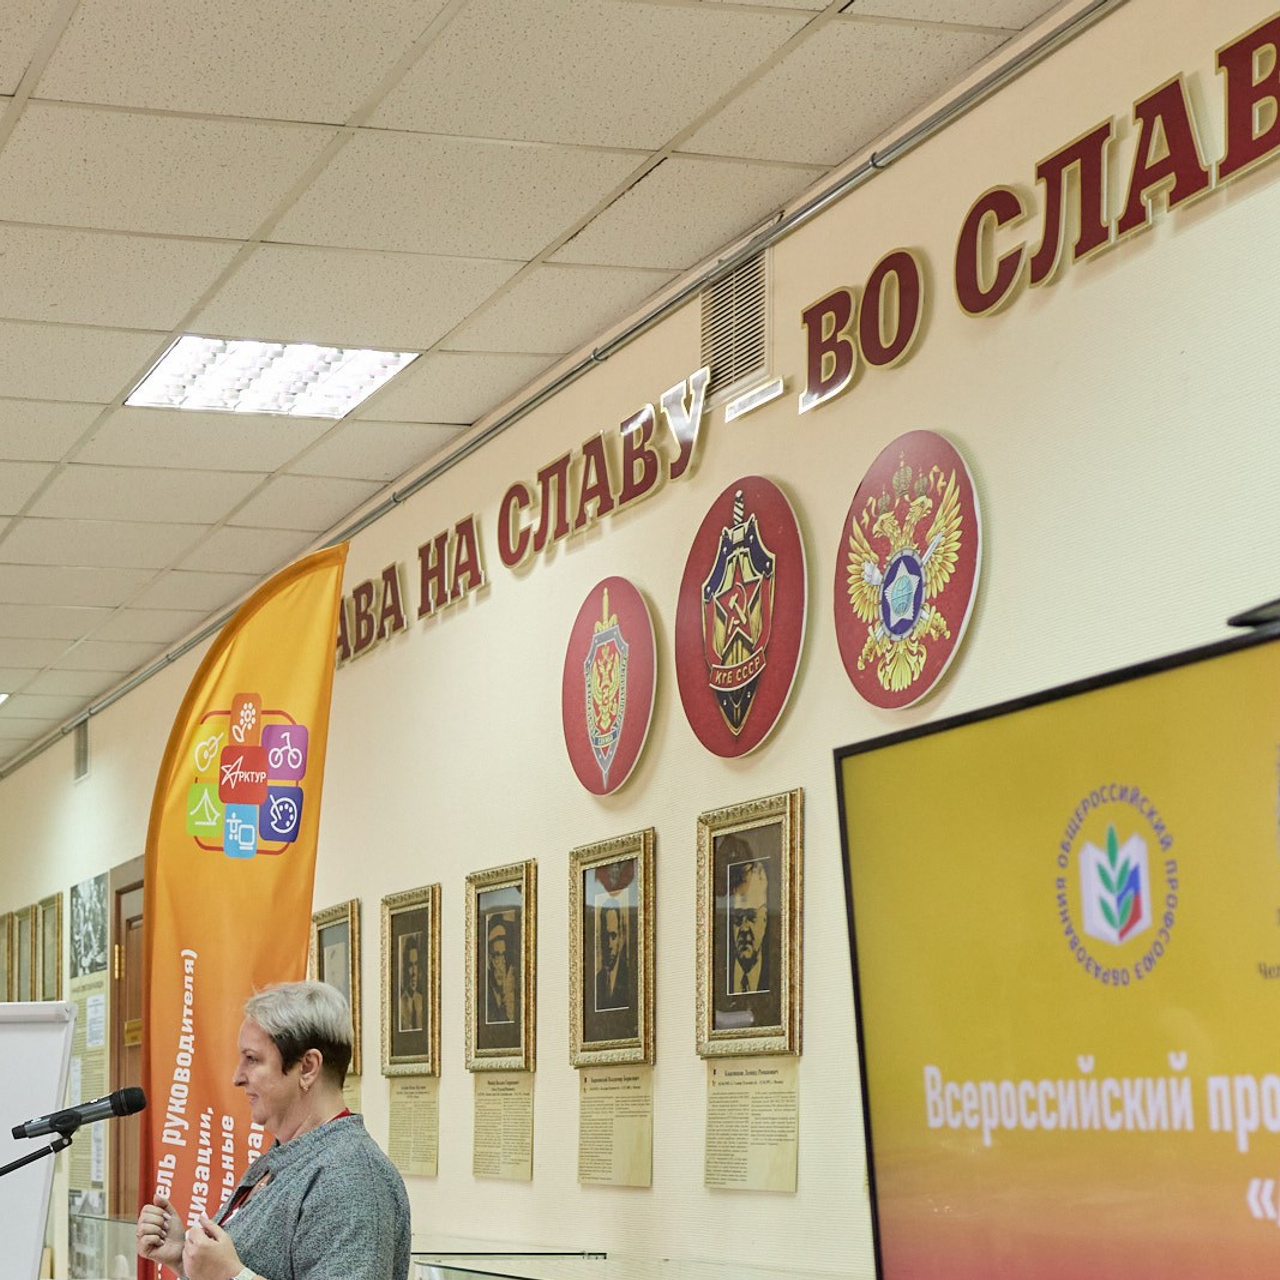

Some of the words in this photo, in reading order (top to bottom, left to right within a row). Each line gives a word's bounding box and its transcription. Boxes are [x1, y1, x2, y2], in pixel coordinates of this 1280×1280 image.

[417, 514, 486, 620] НА
[497, 366, 711, 569] СЛАВУ
[799, 247, 924, 415] ВО
[735, 656, 760, 682] СССР
[1134, 858, 1179, 981] ПРОФСОЮЗ
[161, 948, 199, 1147] руководителя)
[923, 1051, 1195, 1148] Всероссийский
